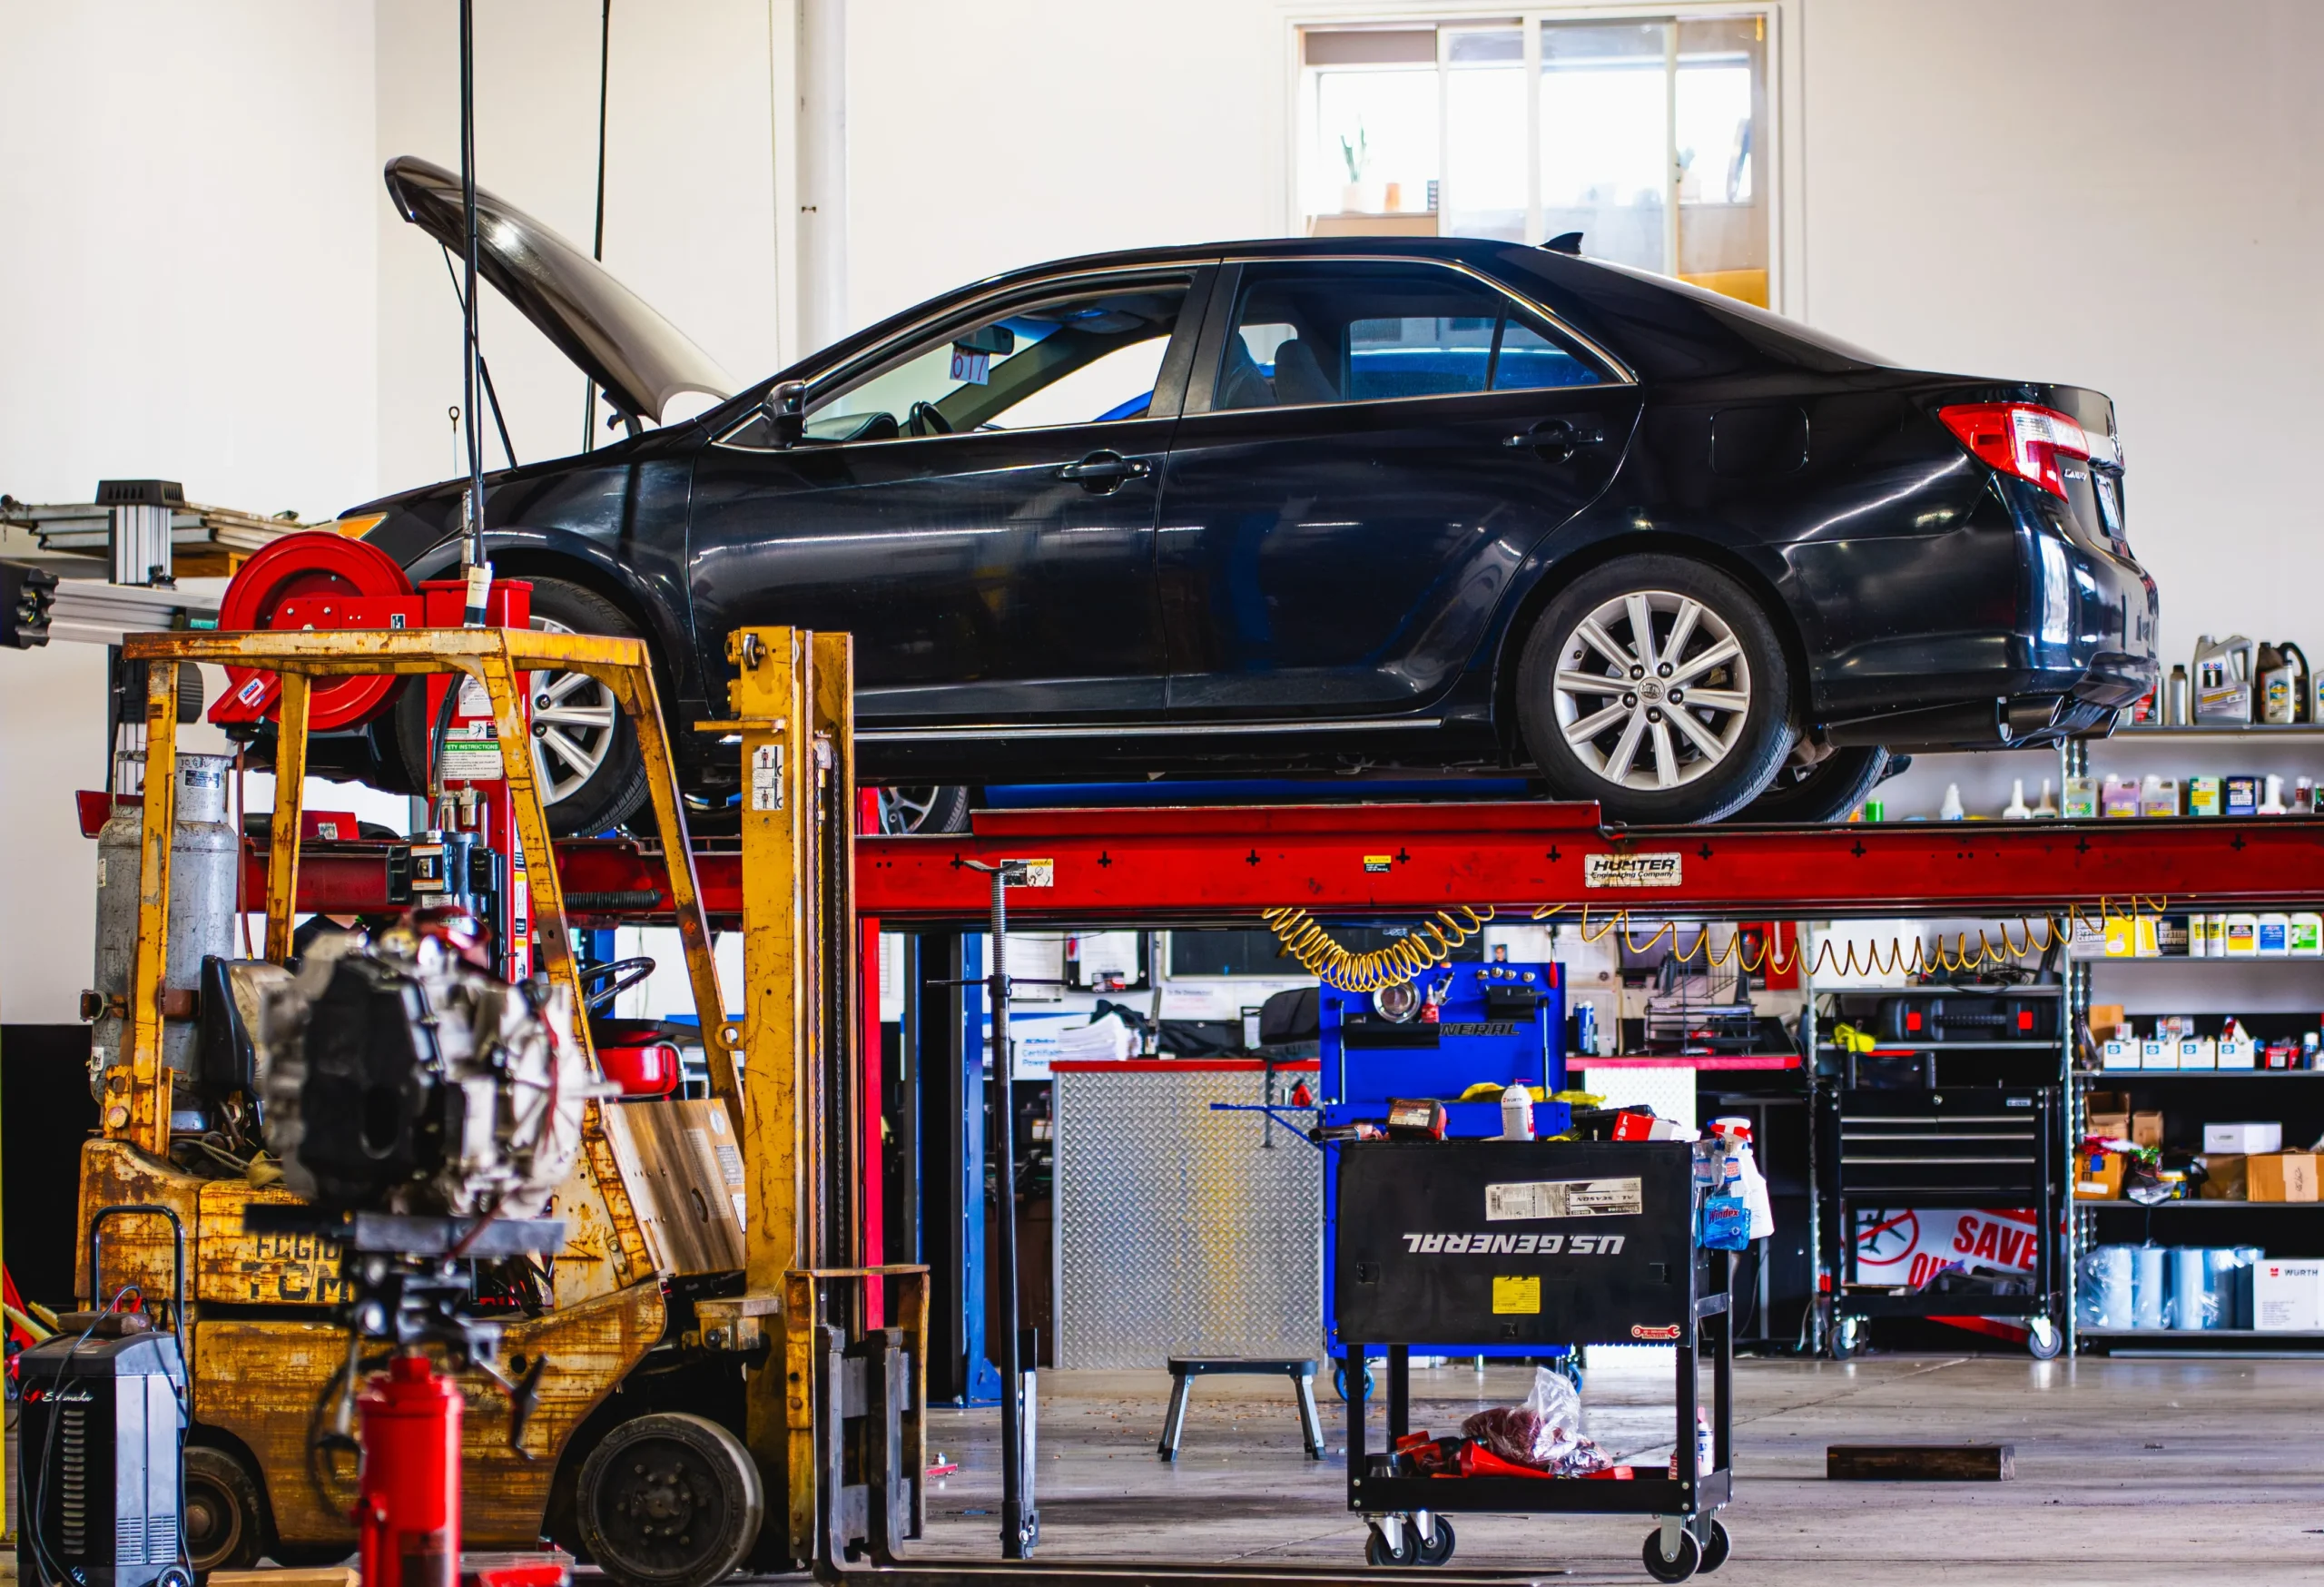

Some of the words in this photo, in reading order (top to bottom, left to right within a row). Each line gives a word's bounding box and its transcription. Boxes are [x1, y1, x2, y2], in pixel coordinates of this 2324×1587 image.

[2202, 662, 2222, 670] Mobil
[1593, 859, 1676, 871] HUNTER
[1439, 1022, 1521, 1037] NERAL
[1708, 1208, 1739, 1225] Windex
[1402, 1234, 1565, 1255] GENERAL
[1954, 1215, 2038, 1272] SAVE
